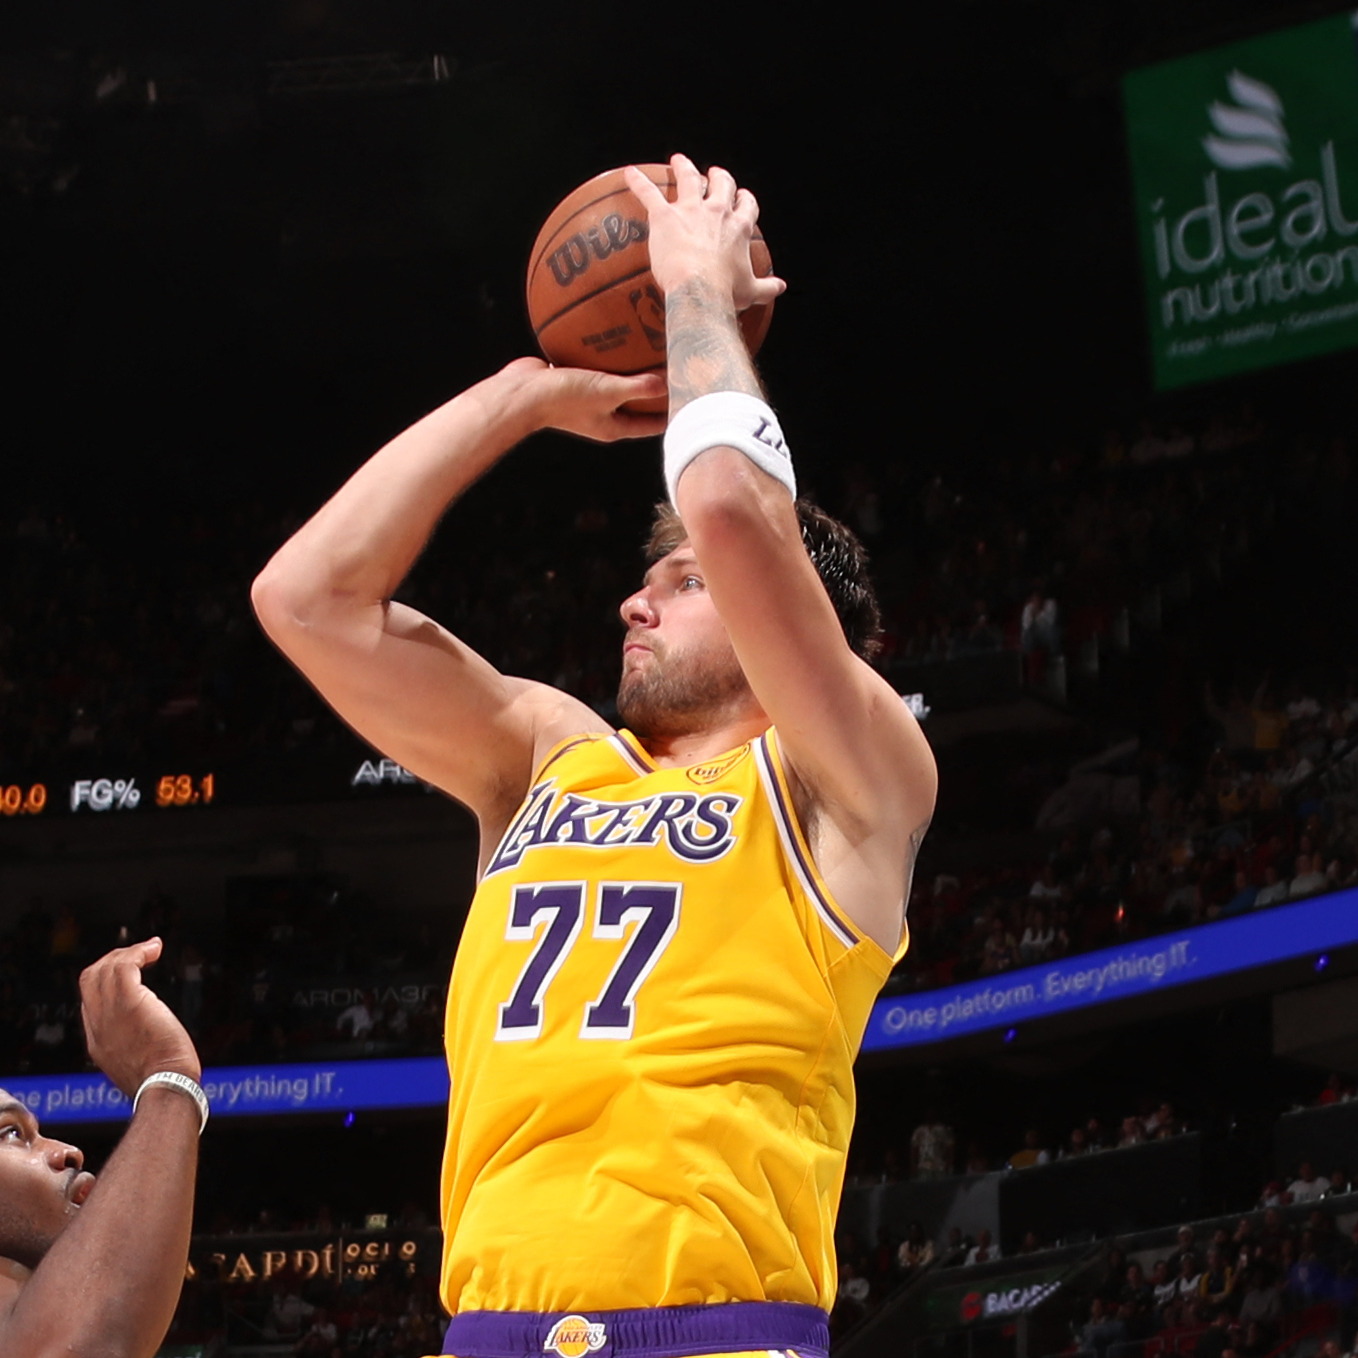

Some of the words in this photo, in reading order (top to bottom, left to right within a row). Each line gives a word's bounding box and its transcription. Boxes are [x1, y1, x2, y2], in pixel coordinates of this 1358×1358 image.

[546, 212, 649, 287] Wils
[71, 779, 141, 811] FG%
[157, 775, 215, 808] 53.1
[480, 776, 742, 879] LAKERS
[494, 880, 683, 1041] 77
[884, 1003, 937, 1034] One
[1046, 947, 1164, 1001] Everything
[314, 1070, 343, 1096] IT.
